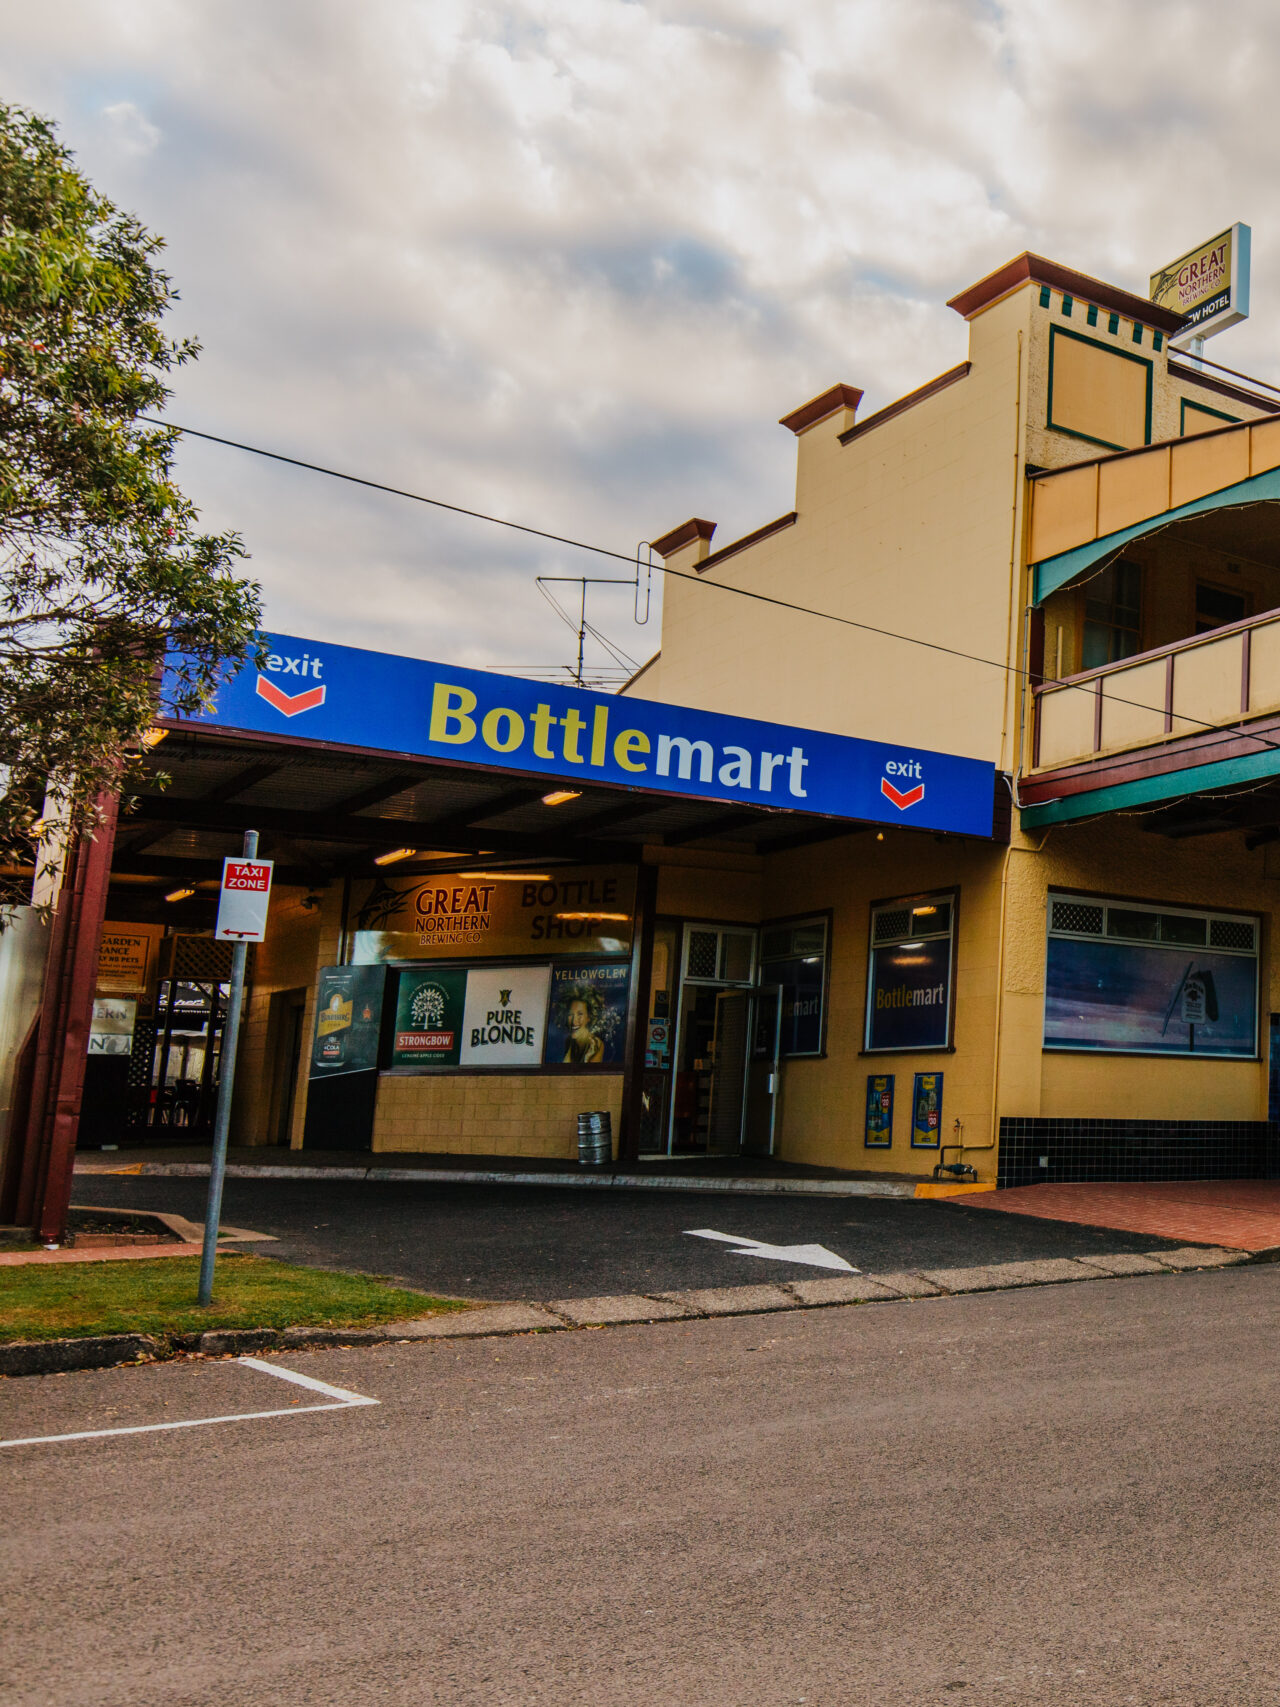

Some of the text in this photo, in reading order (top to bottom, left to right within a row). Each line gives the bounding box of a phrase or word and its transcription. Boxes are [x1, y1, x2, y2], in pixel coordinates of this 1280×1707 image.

[1178, 243, 1228, 287] GREAT
[1178, 264, 1226, 300] NORTHERN
[1182, 286, 1209, 306] BREWING
[1202, 294, 1230, 317] HOTEL
[265, 652, 323, 680] exit
[428, 682, 810, 798] Bottlemart
[885, 759, 924, 780] exit
[234, 866, 263, 877] TAXI
[228, 878, 265, 889] ZONE
[521, 879, 618, 907] BOTTLE
[415, 885, 497, 916] GREAT
[415, 915, 491, 933] NORTHERN
[531, 915, 602, 940] SHOP
[419, 932, 465, 945] BREWING
[555, 968, 627, 980] YELLOWGLEN
[877, 983, 944, 1009] Bottlemart
[486, 1010, 522, 1025] PURE
[399, 1035, 451, 1046] STRONGBOW
[471, 1025, 535, 1047] BLONDE
